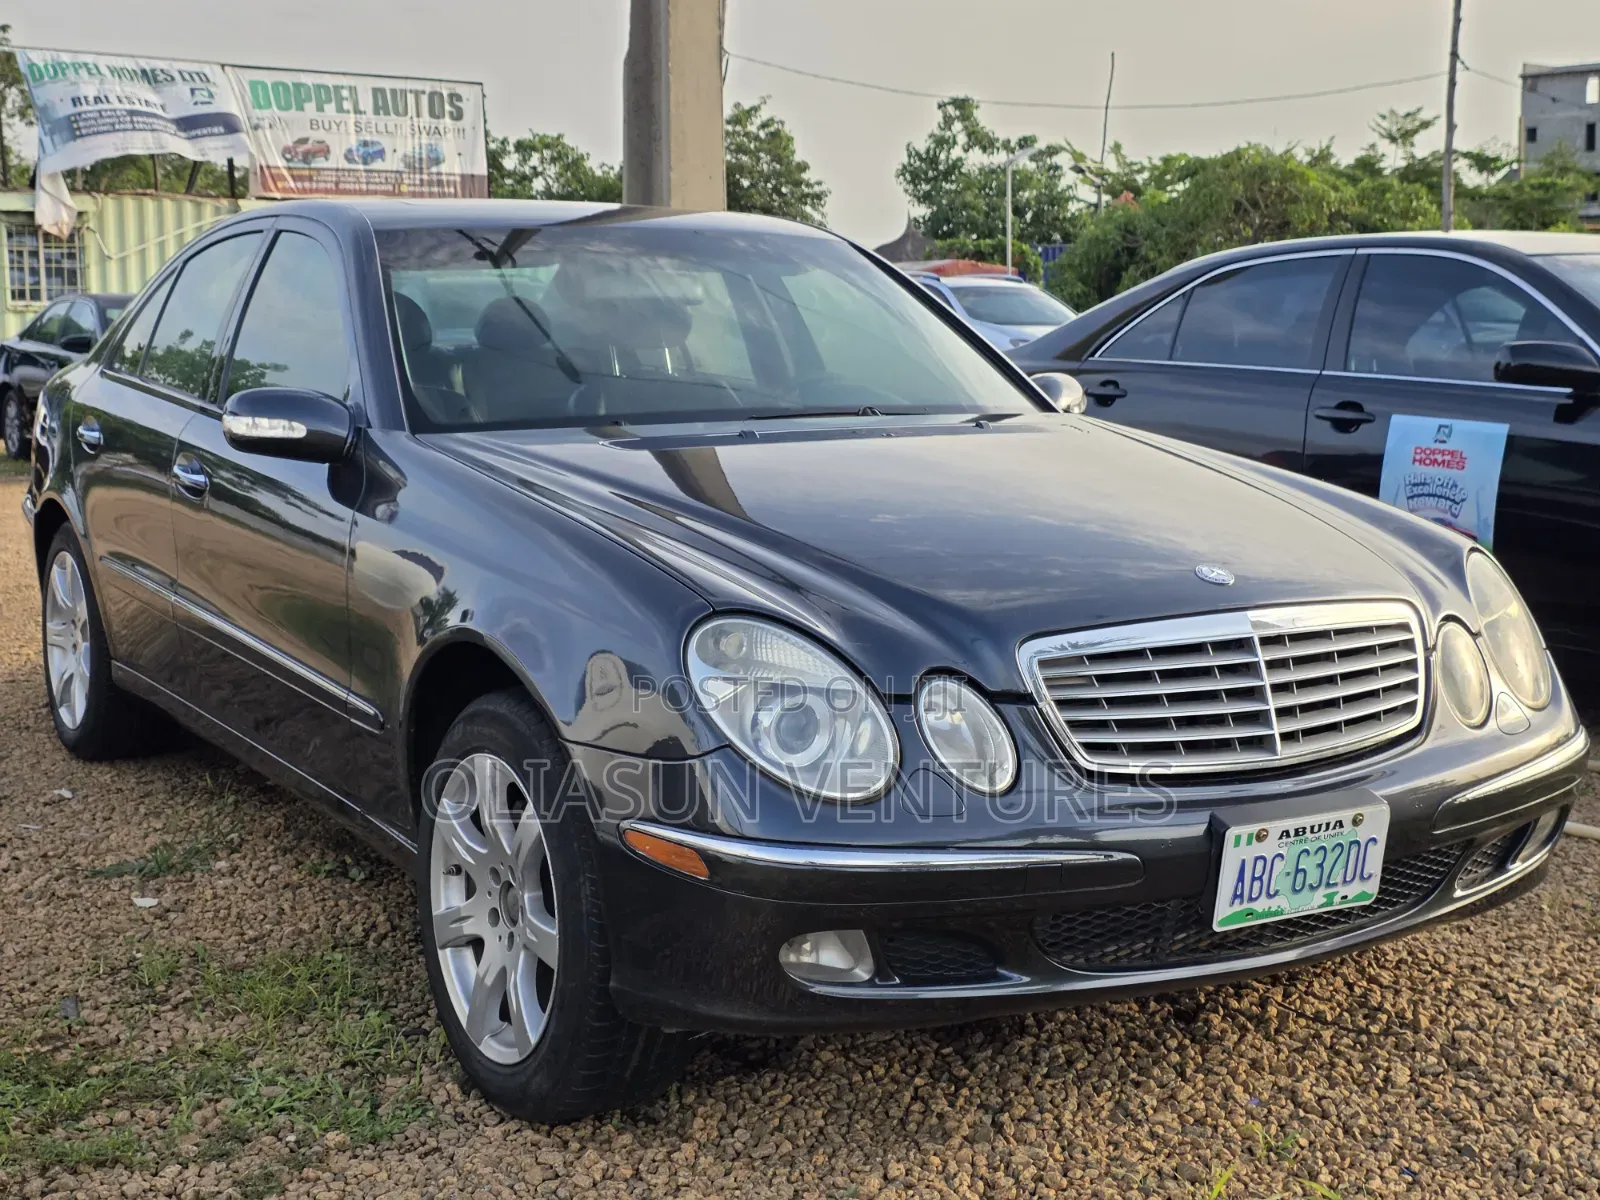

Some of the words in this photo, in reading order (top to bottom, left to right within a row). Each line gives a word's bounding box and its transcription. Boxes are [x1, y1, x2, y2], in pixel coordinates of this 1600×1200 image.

[27, 61, 105, 84] DOPPEL
[105, 63, 176, 85] HOMES
[71, 94, 112, 108] REAL
[249, 79, 366, 116] DOPPEL
[371, 87, 465, 121] AUTOS
[1414, 446, 1467, 460] DOPPEL
[1412, 456, 1466, 471] HOMES
[1277, 819, 1345, 841] ABUJA
[1277, 837, 1309, 849] CENTRE
[1310, 835, 1322, 843] OF
[1323, 831, 1345, 841] UNITY
[1229, 837, 1378, 907] ABC-632DC
